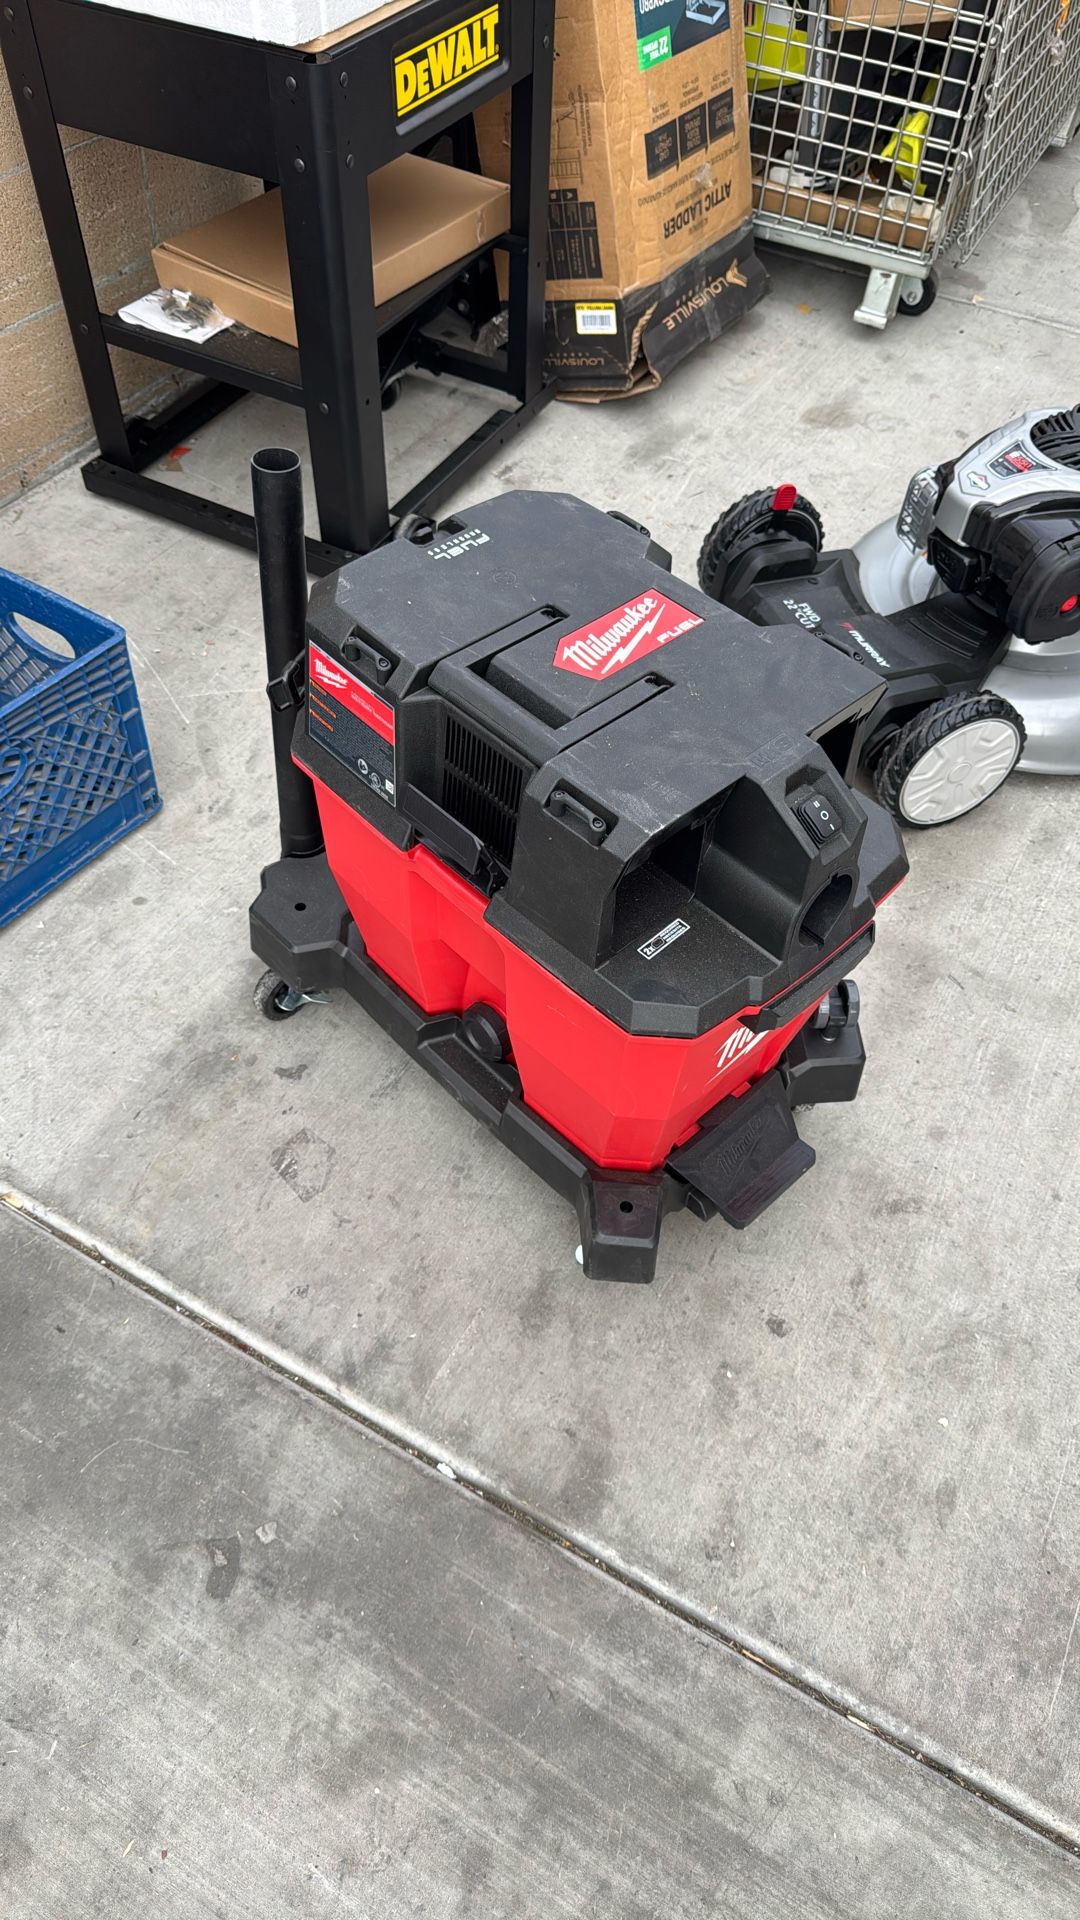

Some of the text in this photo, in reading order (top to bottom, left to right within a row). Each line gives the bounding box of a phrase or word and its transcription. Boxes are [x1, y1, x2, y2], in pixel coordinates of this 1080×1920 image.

[704, 179, 732, 212] ATTIC
[663, 198, 703, 239] LADDER
[662, 276, 729, 331] LOUISVILLE
[543, 357, 605, 367] LOUISVILL
[433, 533, 490, 560] FUEL
[798, 602, 821, 623] FWD
[562, 597, 658, 671] Milwaukee
[656, 618, 704, 643] FUEL
[848, 629, 891, 668] MURRAY
